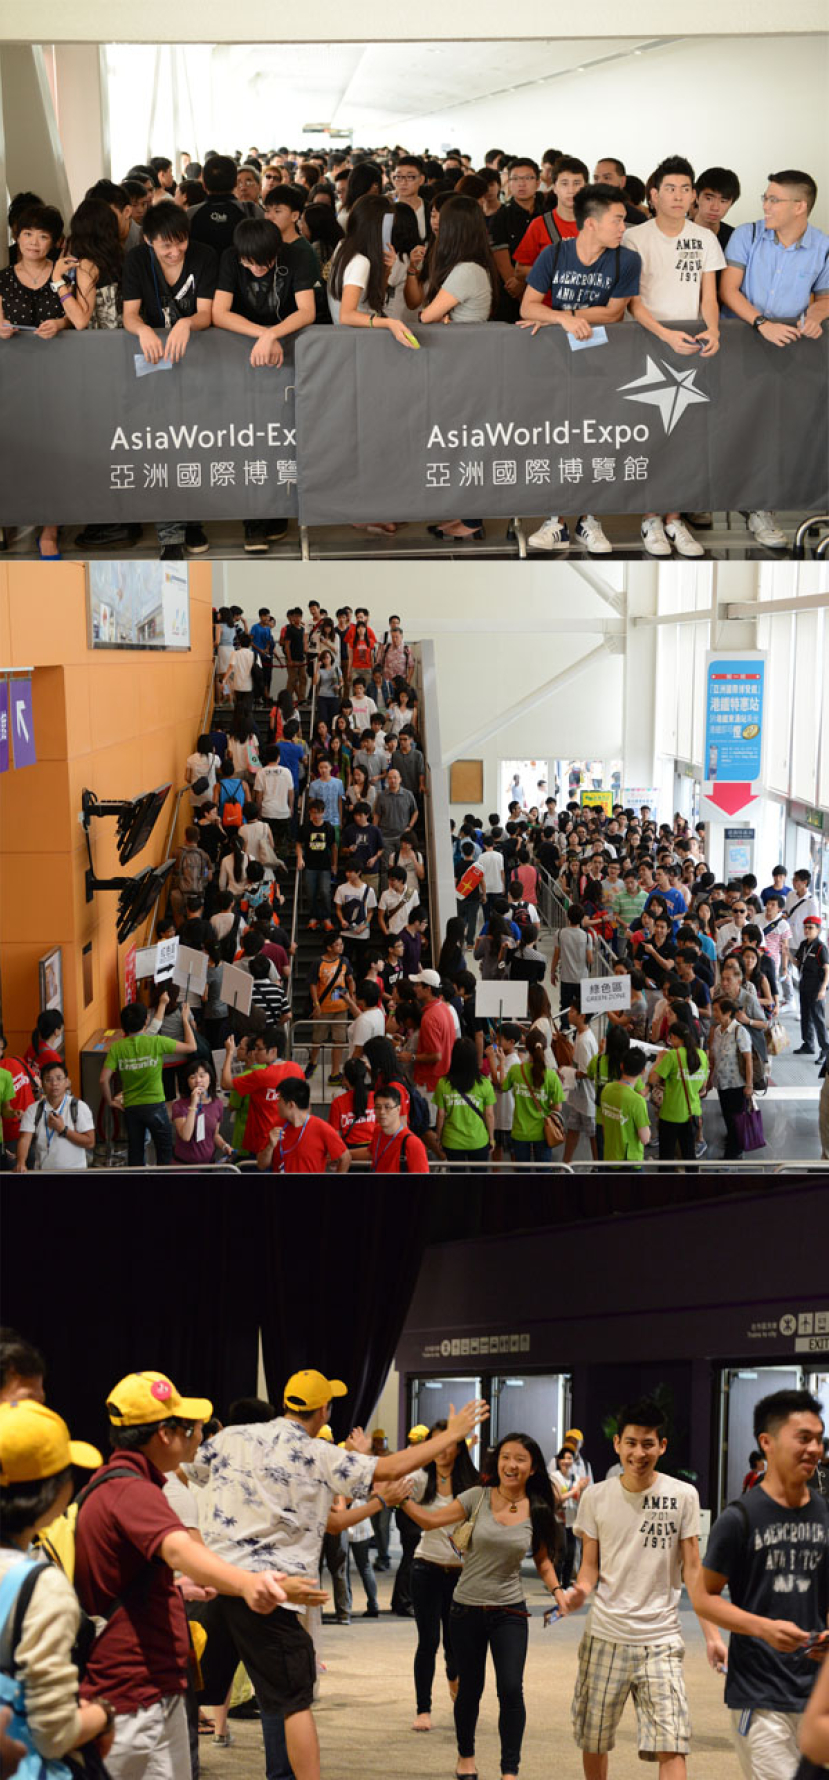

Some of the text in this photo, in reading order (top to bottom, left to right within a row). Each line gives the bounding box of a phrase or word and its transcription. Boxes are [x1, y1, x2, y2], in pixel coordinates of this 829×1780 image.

[676, 238, 704, 250] AMER
[427, 420, 650, 450] AsiaWorld-Expo
[425, 456, 650, 488] 亞洲國際博覽館
[809, 1338, 829, 1350] EXIT
[642, 1495, 678, 1510] AMER
